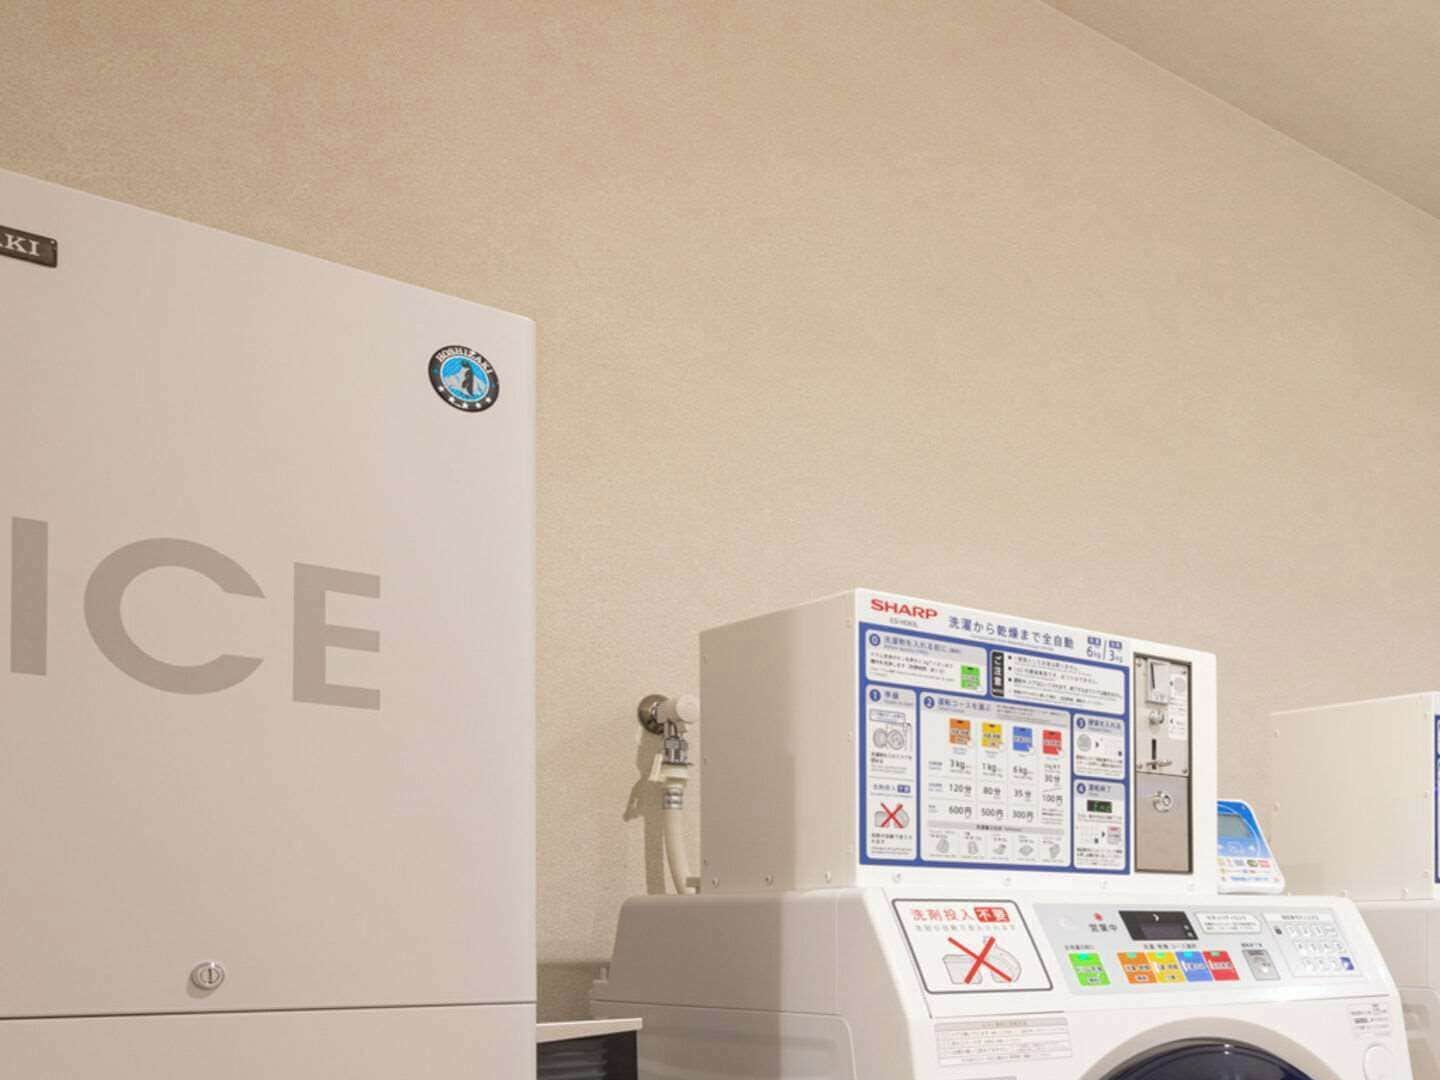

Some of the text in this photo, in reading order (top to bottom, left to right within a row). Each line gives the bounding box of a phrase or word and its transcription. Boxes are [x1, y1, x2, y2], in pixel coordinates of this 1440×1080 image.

[0, 233, 40, 257] KI
[10, 515, 381, 711] ICE
[870, 599, 938, 619] SHARP
[911, 908, 974, 922] 洗剤投入
